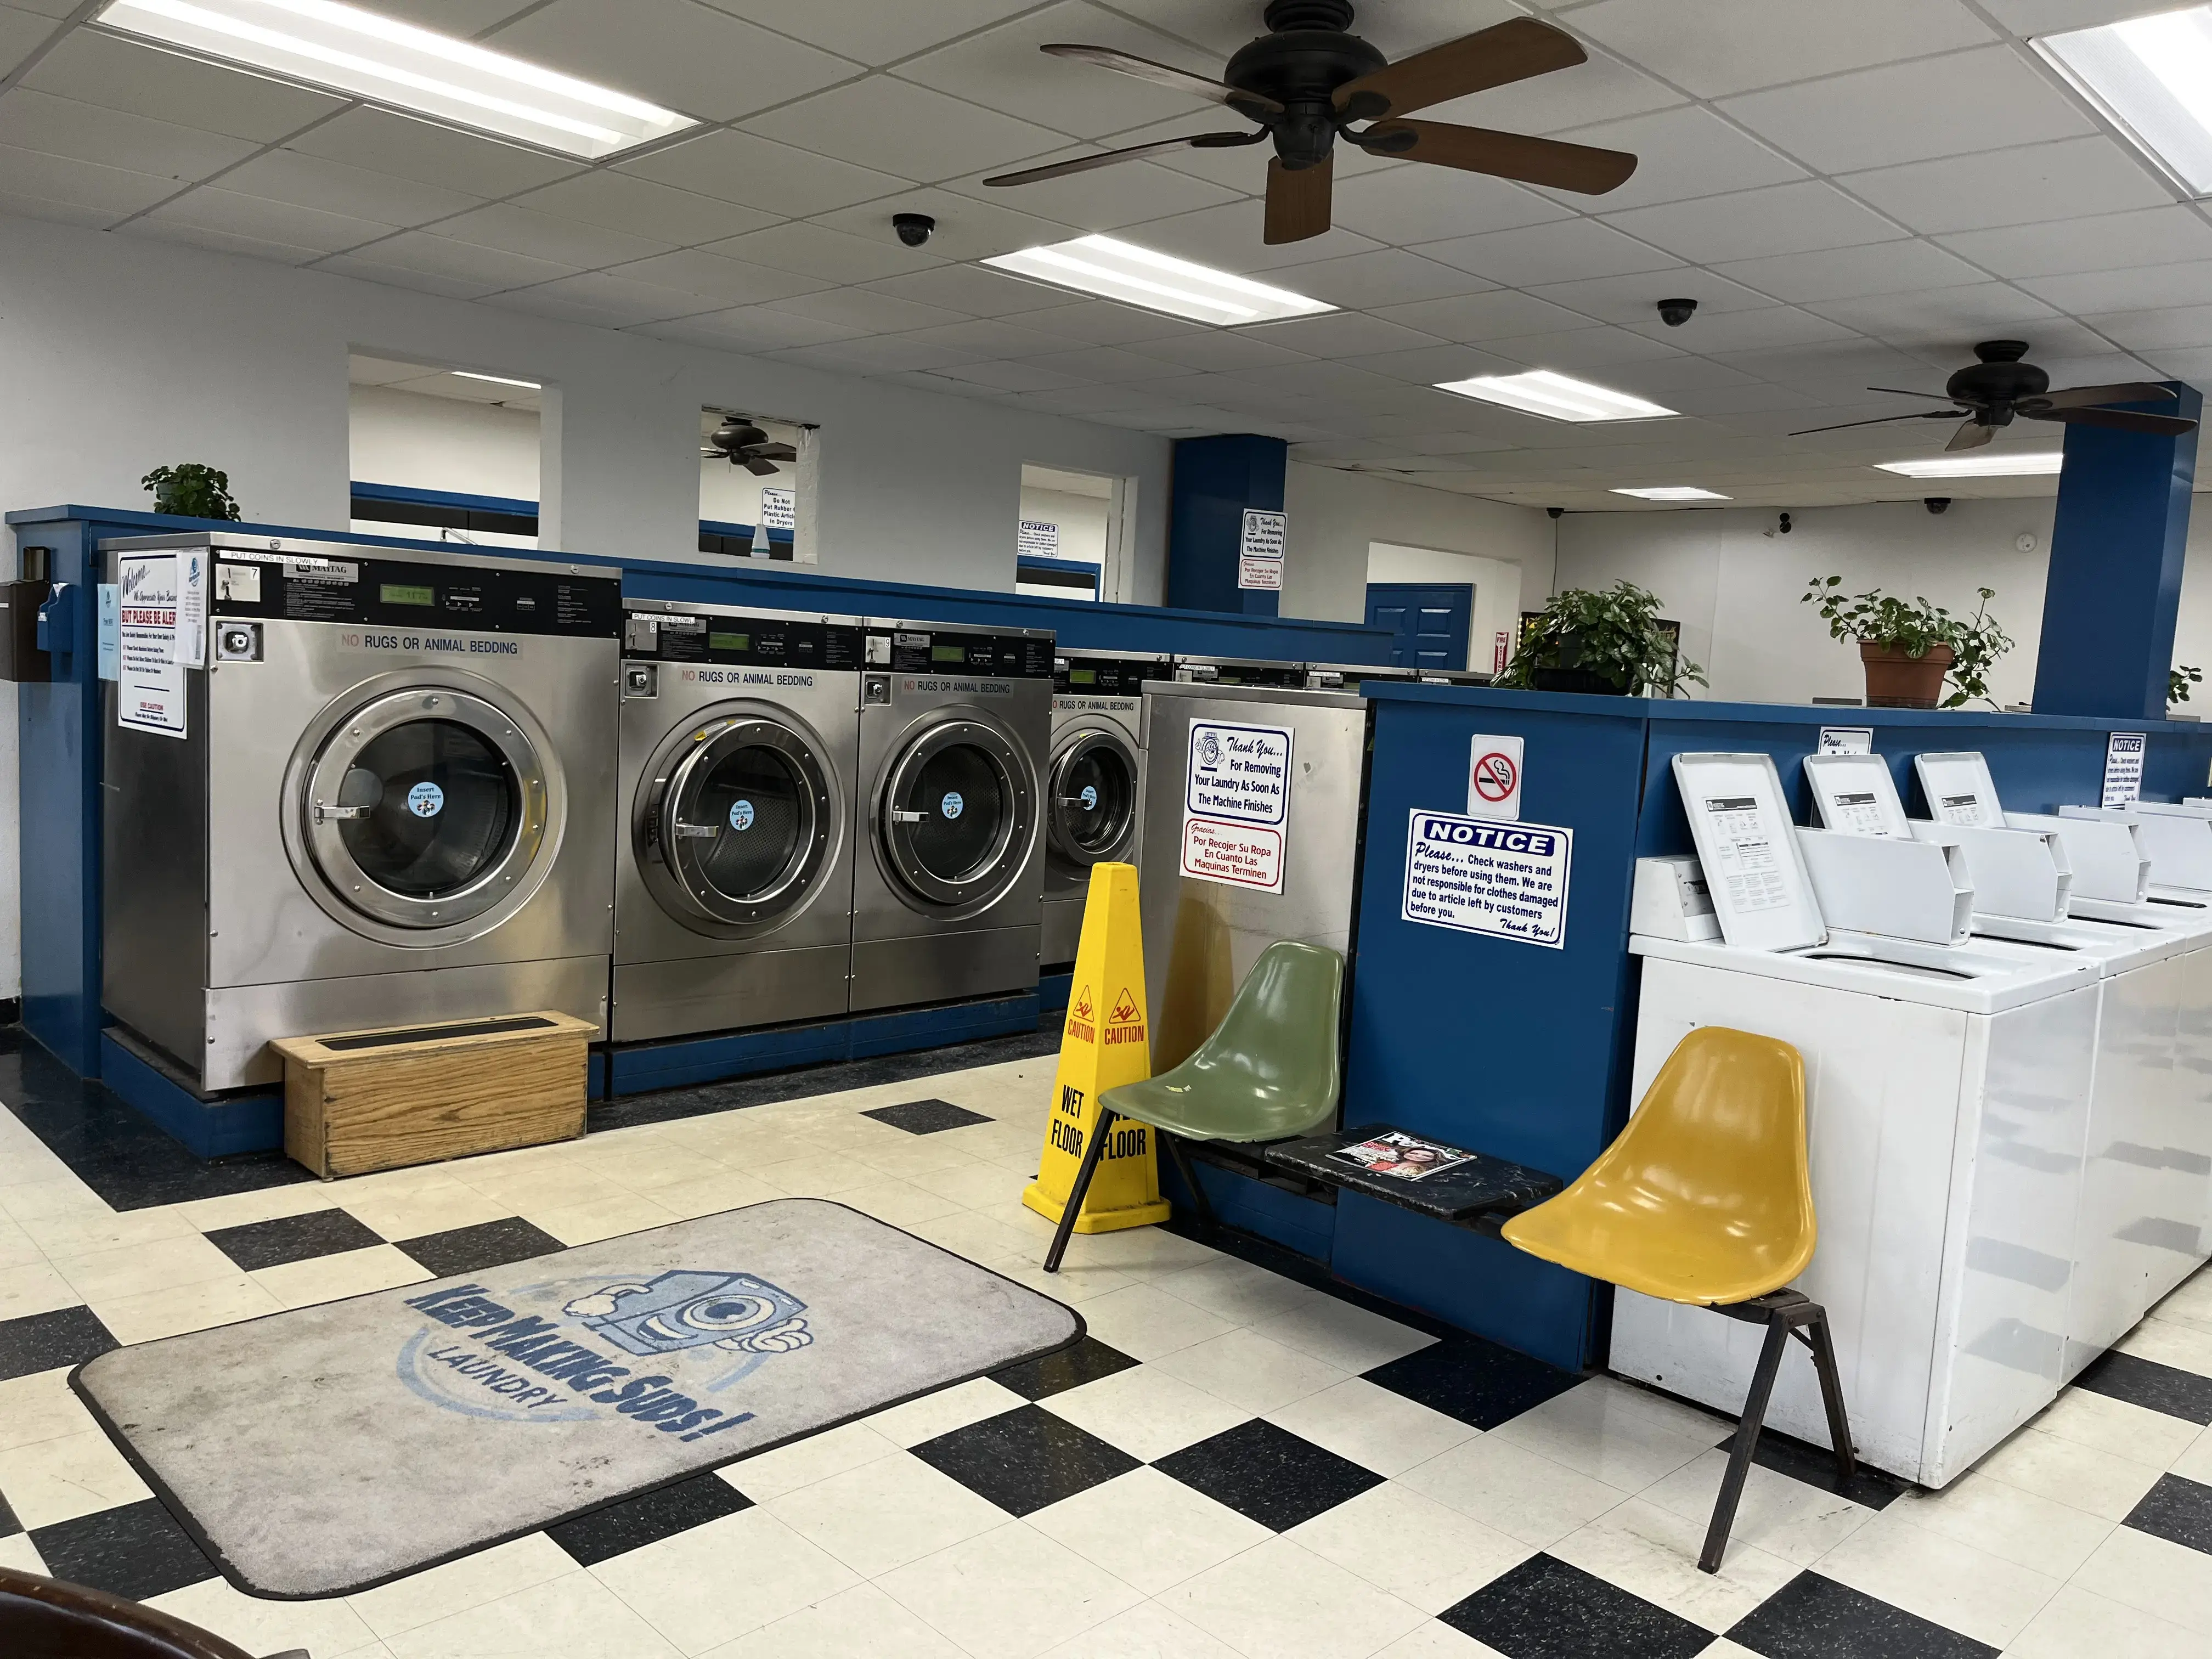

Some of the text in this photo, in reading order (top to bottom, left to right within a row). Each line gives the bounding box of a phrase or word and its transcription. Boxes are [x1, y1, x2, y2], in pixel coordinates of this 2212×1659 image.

[1023, 523, 1054, 532] NOTICE
[249, 553, 274, 561] COINS
[286, 556, 318, 565] SLOWLY
[252, 568, 258, 579] 7
[122, 610, 132, 623] BUT
[133, 610, 152, 624] PLEASE
[154, 611, 160, 624] BE
[162, 611, 176, 625] ALER
[651, 623, 656, 631] 8
[342, 634, 517, 654] NO RUGS OR ANIMAL BEDDING
[885, 639, 889, 647] 9
[682, 670, 812, 686] NO RUGS OR ANIMAL BEDDING
[904, 680, 1009, 693] NO RUGS OR ANIMAL BEDDING
[1053, 700, 1134, 710] O RUGS OR ANIMAL BEDDING
[1227, 736, 1282, 759] Thank You...
[2113, 740, 2140, 751] NOTICE
[1231, 759, 1281, 778] For Removing
[1195, 774, 1280, 794] Your Laundry As Soon As
[1198, 793, 1273, 813] The Machine Finishes
[1193, 836, 1271, 857] Por Recojer Su Ropa
[1429, 823, 1549, 854] NOTICE
[1205, 849, 1257, 866] En Cuanto Las
[1415, 842, 1551, 876] Please... Check washers and
[1194, 858, 1266, 879] Maquinas Terminen
[1414, 860, 1552, 891] dryers before using them. We are
[1413, 876, 1558, 908] not responsible for clothes damaged
[1410, 901, 1455, 918] before you.
[1412, 888, 1542, 919] due to article left by customers
[1499, 918, 1555, 938] Thank You!
[1068, 1019, 1095, 1044] CAUTION
[1104, 1025, 1144, 1045] CAUTION
[1062, 1084, 1084, 1119] WET
[1051, 1119, 1083, 1159] FLOOR
[426, 1345, 567, 1408] LAUNDRY
